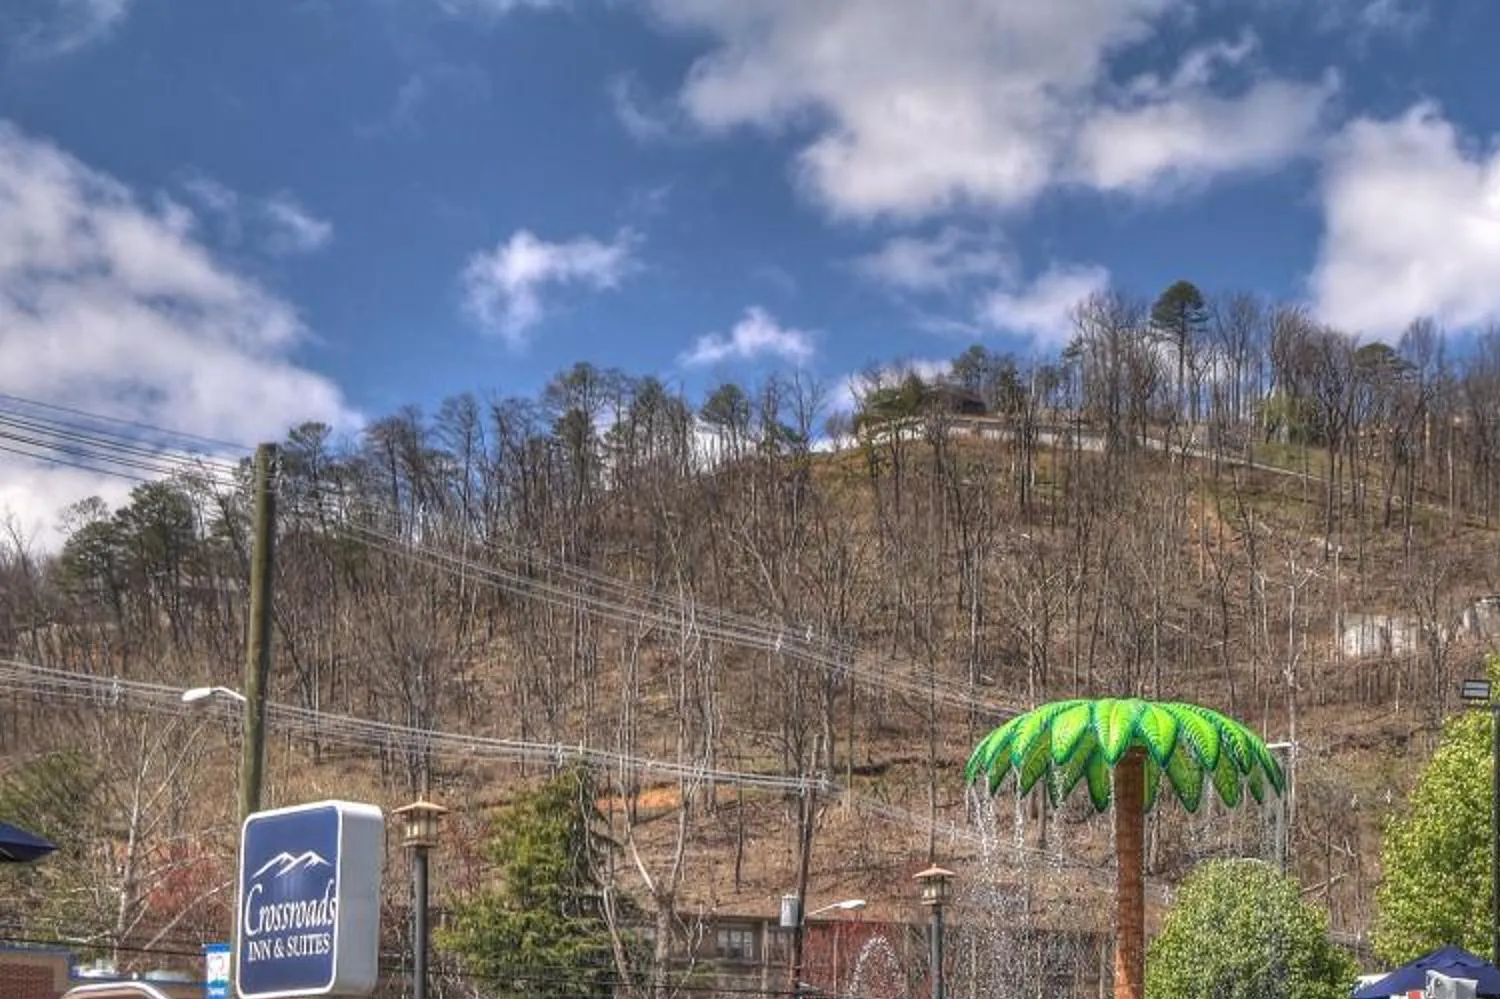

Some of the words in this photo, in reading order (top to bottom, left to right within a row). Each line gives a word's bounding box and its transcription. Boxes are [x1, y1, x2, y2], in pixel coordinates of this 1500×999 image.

[244, 878, 336, 935] Crossroads
[247, 940, 271, 961] INN
[273, 937, 284, 958] &
[287, 933, 331, 957] SUITES
